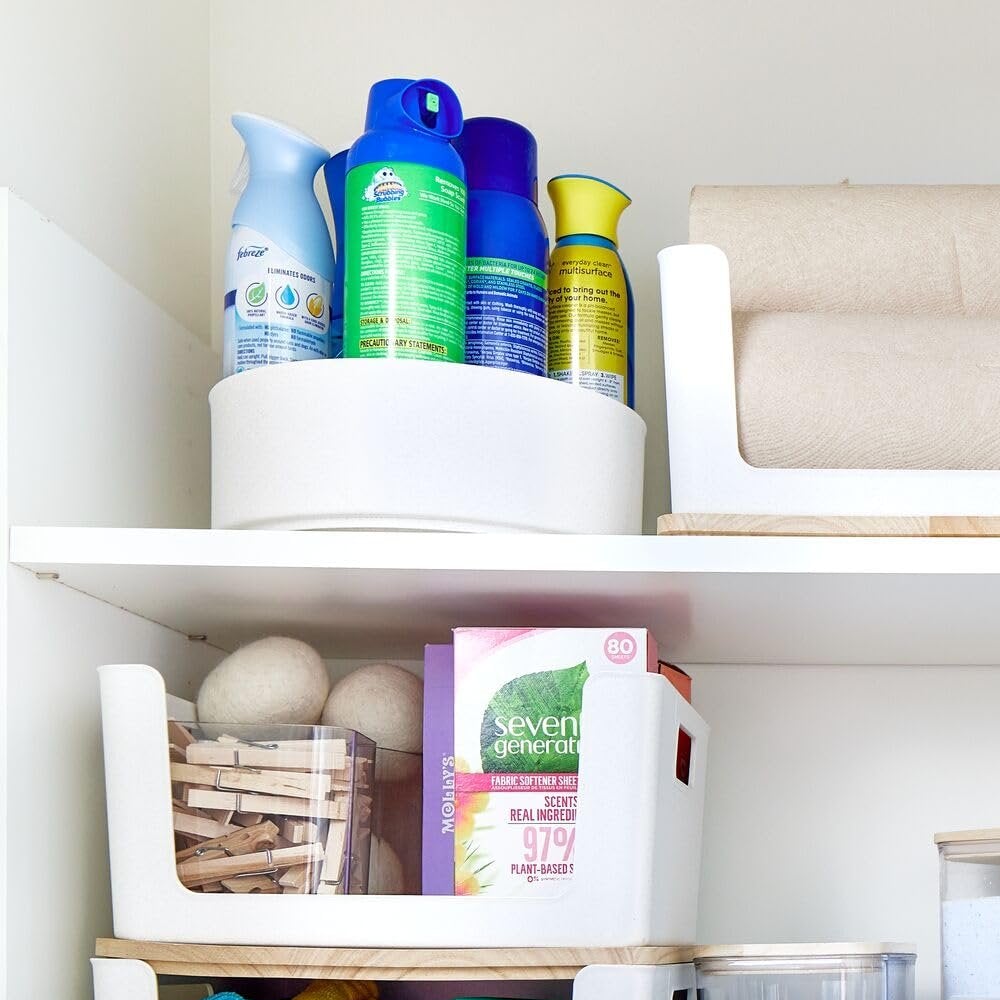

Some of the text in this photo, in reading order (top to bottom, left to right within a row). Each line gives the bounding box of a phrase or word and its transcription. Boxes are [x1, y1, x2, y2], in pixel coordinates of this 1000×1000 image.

[237, 246, 265, 261] febreze
[562, 259, 591, 267] everyday
[560, 267, 612, 278] multisurface
[564, 295, 581, 303] your
[610, 290, 621, 299] the
[360, 339, 407, 348] PRECAUTIOARY
[607, 638, 634, 655] 80
[494, 715, 580, 737] seven
[494, 737, 580, 758] generati
[491, 776, 578, 786] FABRIC SOFTENER SHEE
[510, 808, 577, 821] REAL INGREDI
[511, 864, 568, 875] PLANT-BASED
